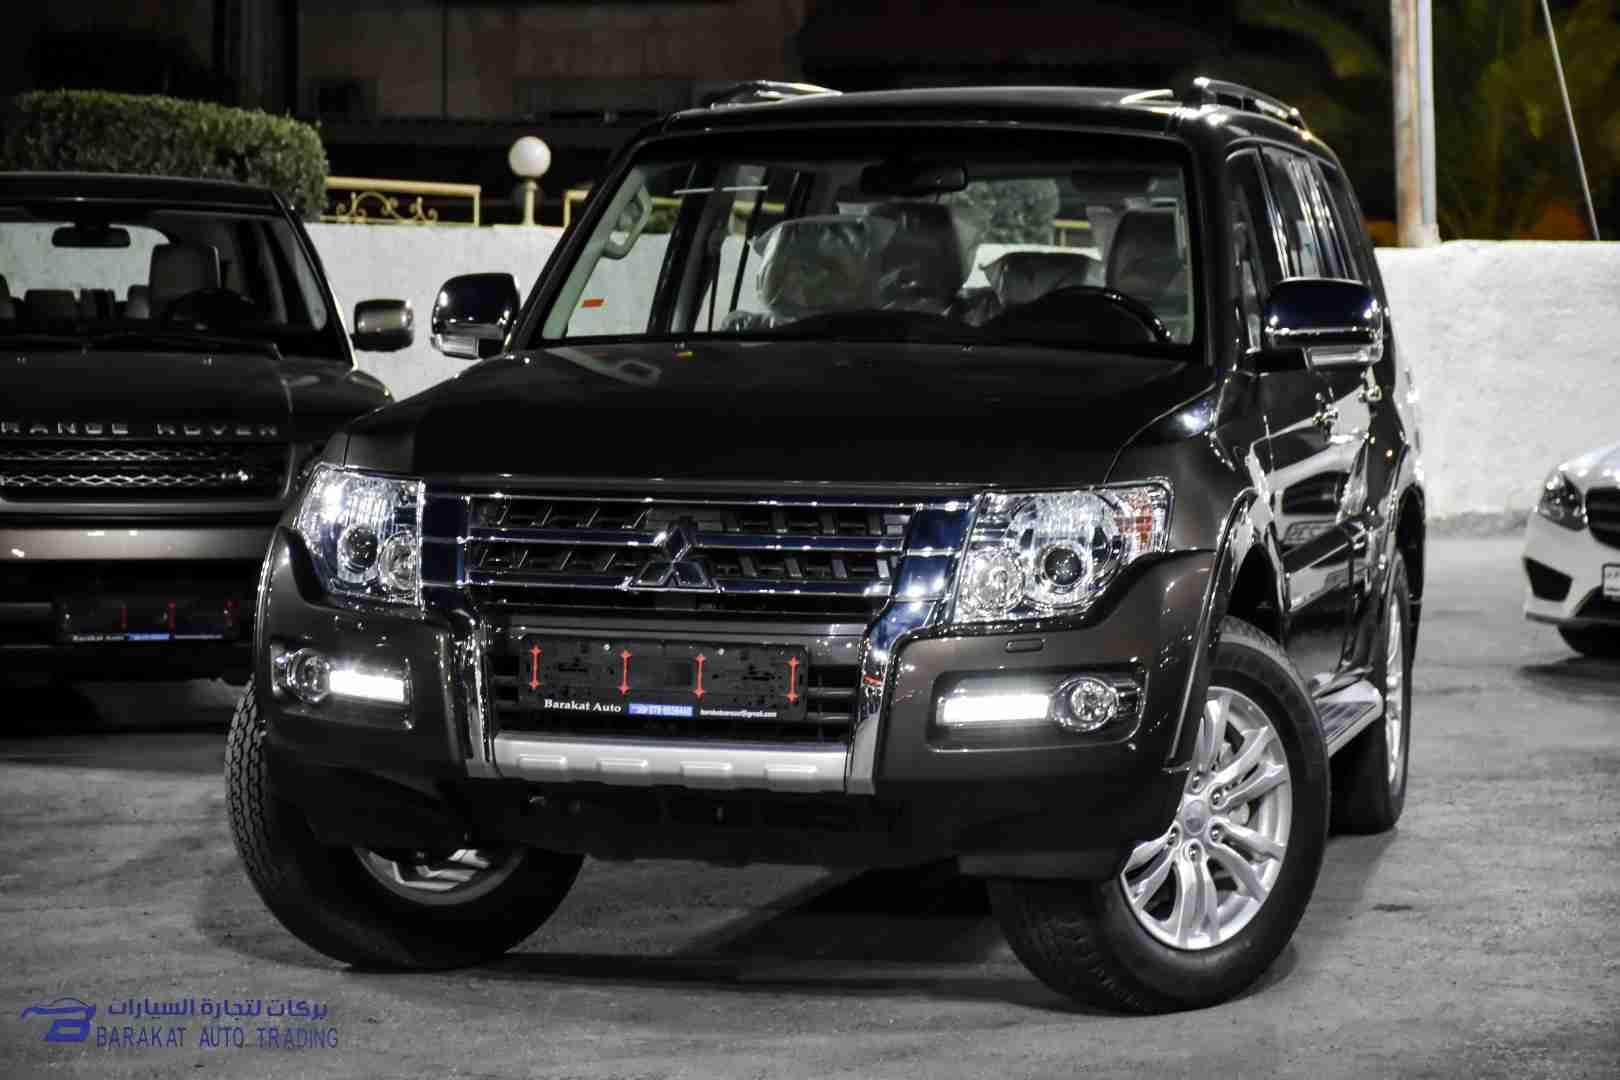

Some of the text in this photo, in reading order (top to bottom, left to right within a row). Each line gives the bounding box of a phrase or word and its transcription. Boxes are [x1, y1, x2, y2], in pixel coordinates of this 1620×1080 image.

[0, 421, 278, 436] RANGE ROVER
[543, 698, 590, 712] Barakat
[593, 702, 622, 713] Auto
